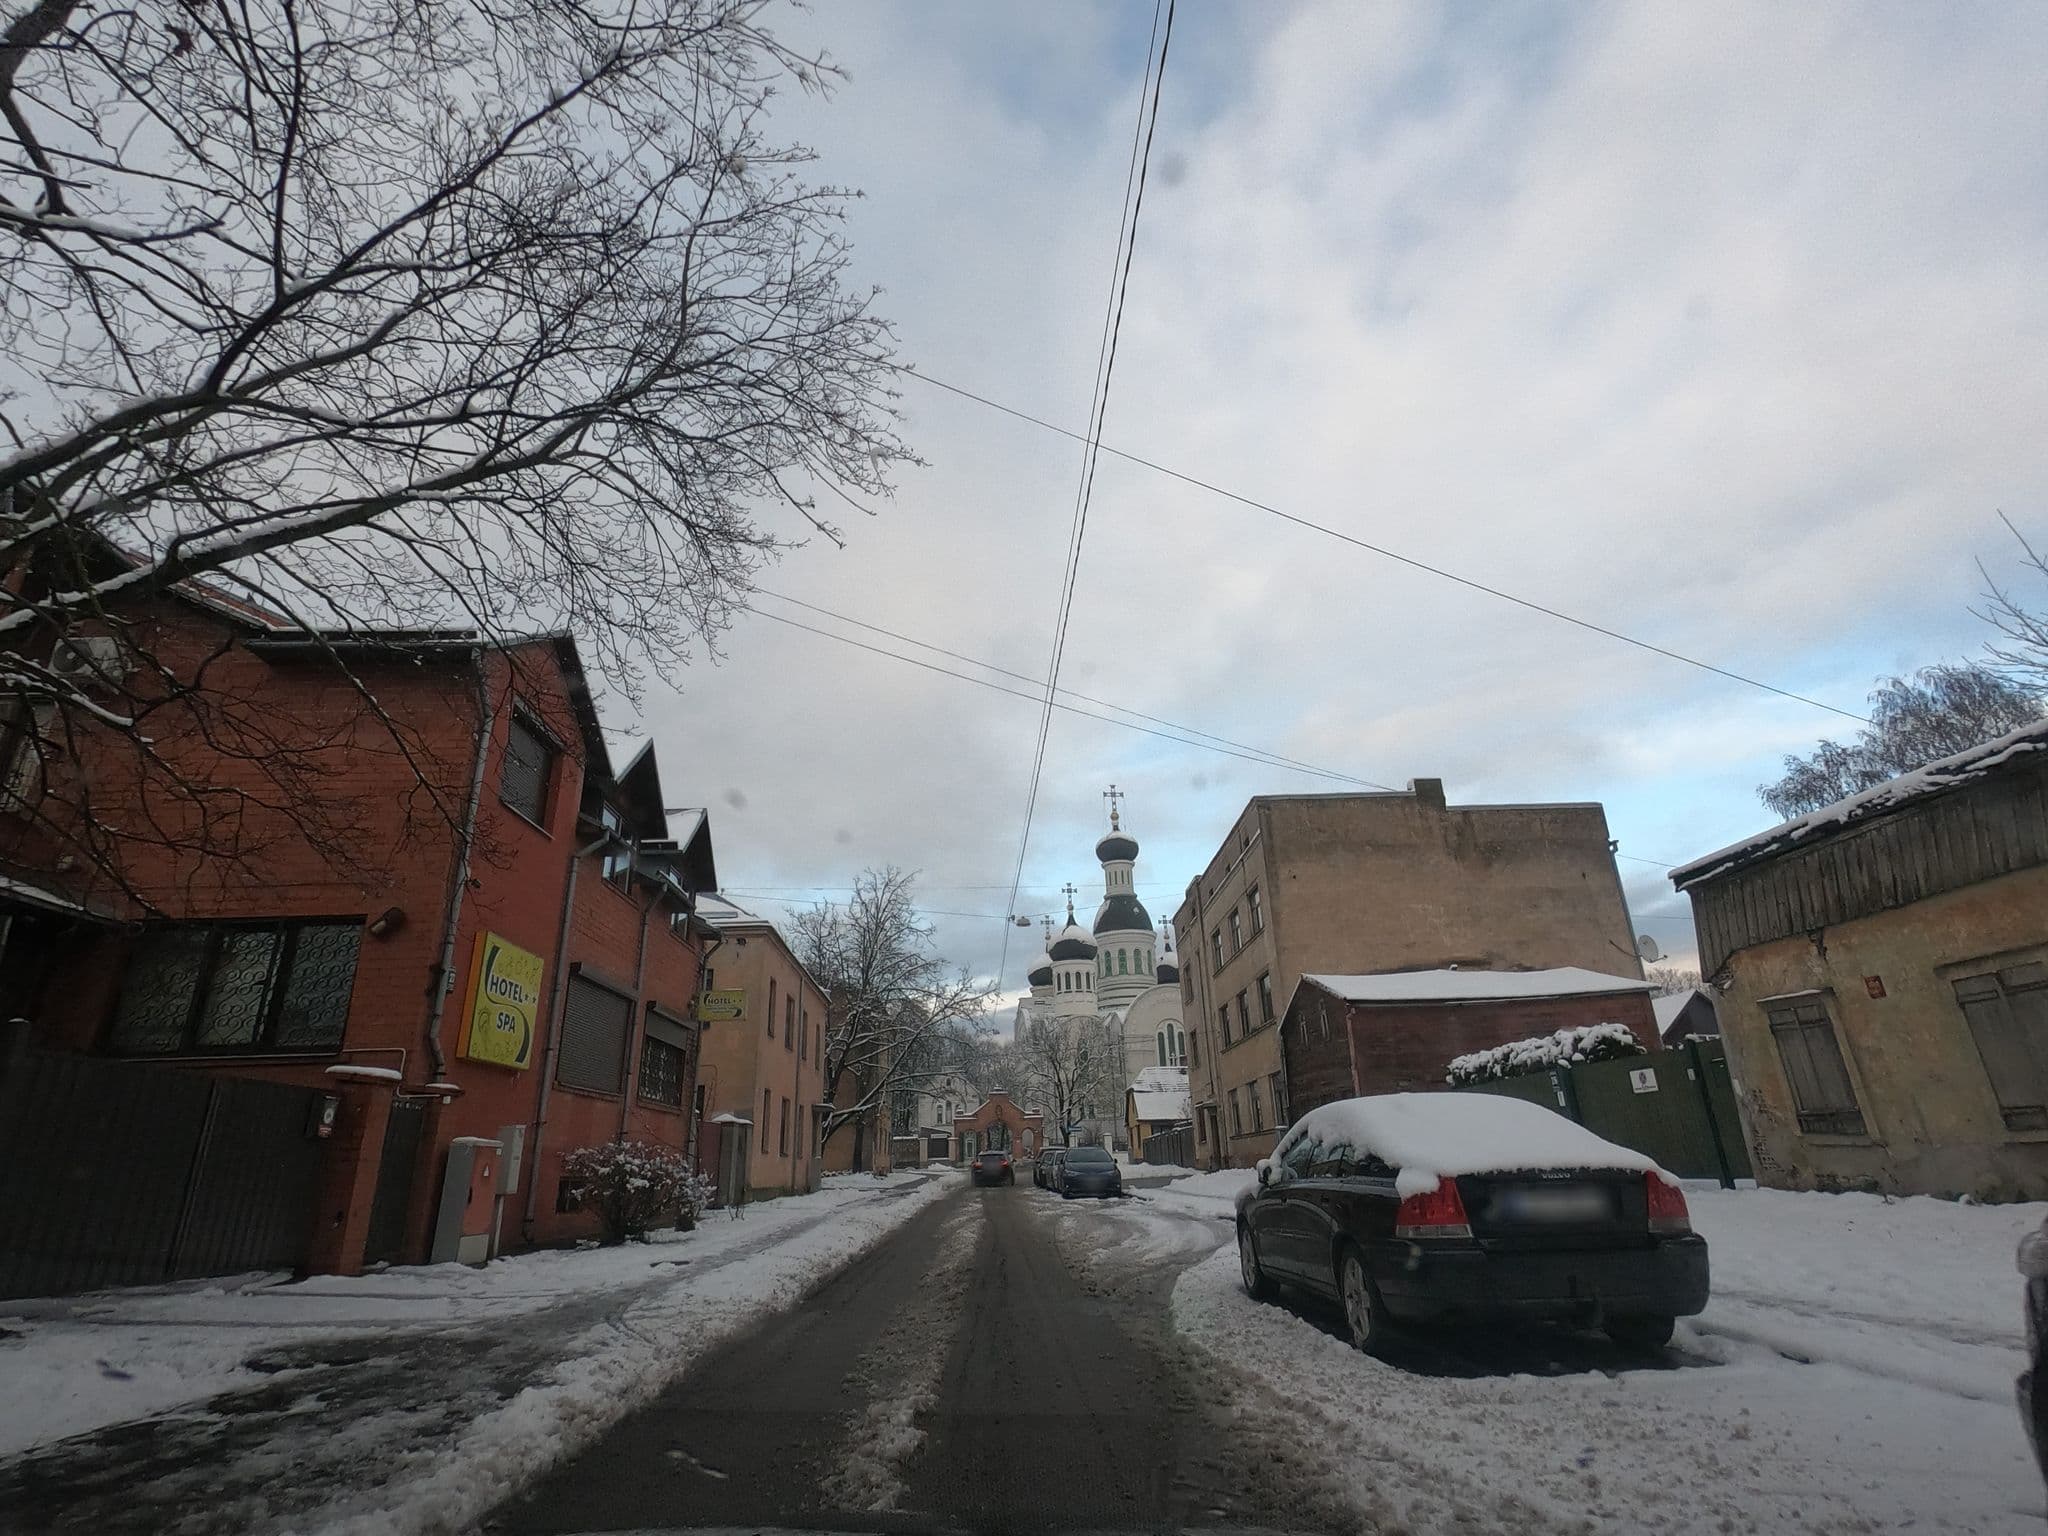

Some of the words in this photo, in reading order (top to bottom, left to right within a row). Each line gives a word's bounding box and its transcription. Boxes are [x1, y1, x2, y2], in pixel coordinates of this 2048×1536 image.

[489, 974, 523, 1003] HOTEL
[707, 997, 731, 1005] HOTEL
[496, 1012, 516, 1034] SPA
